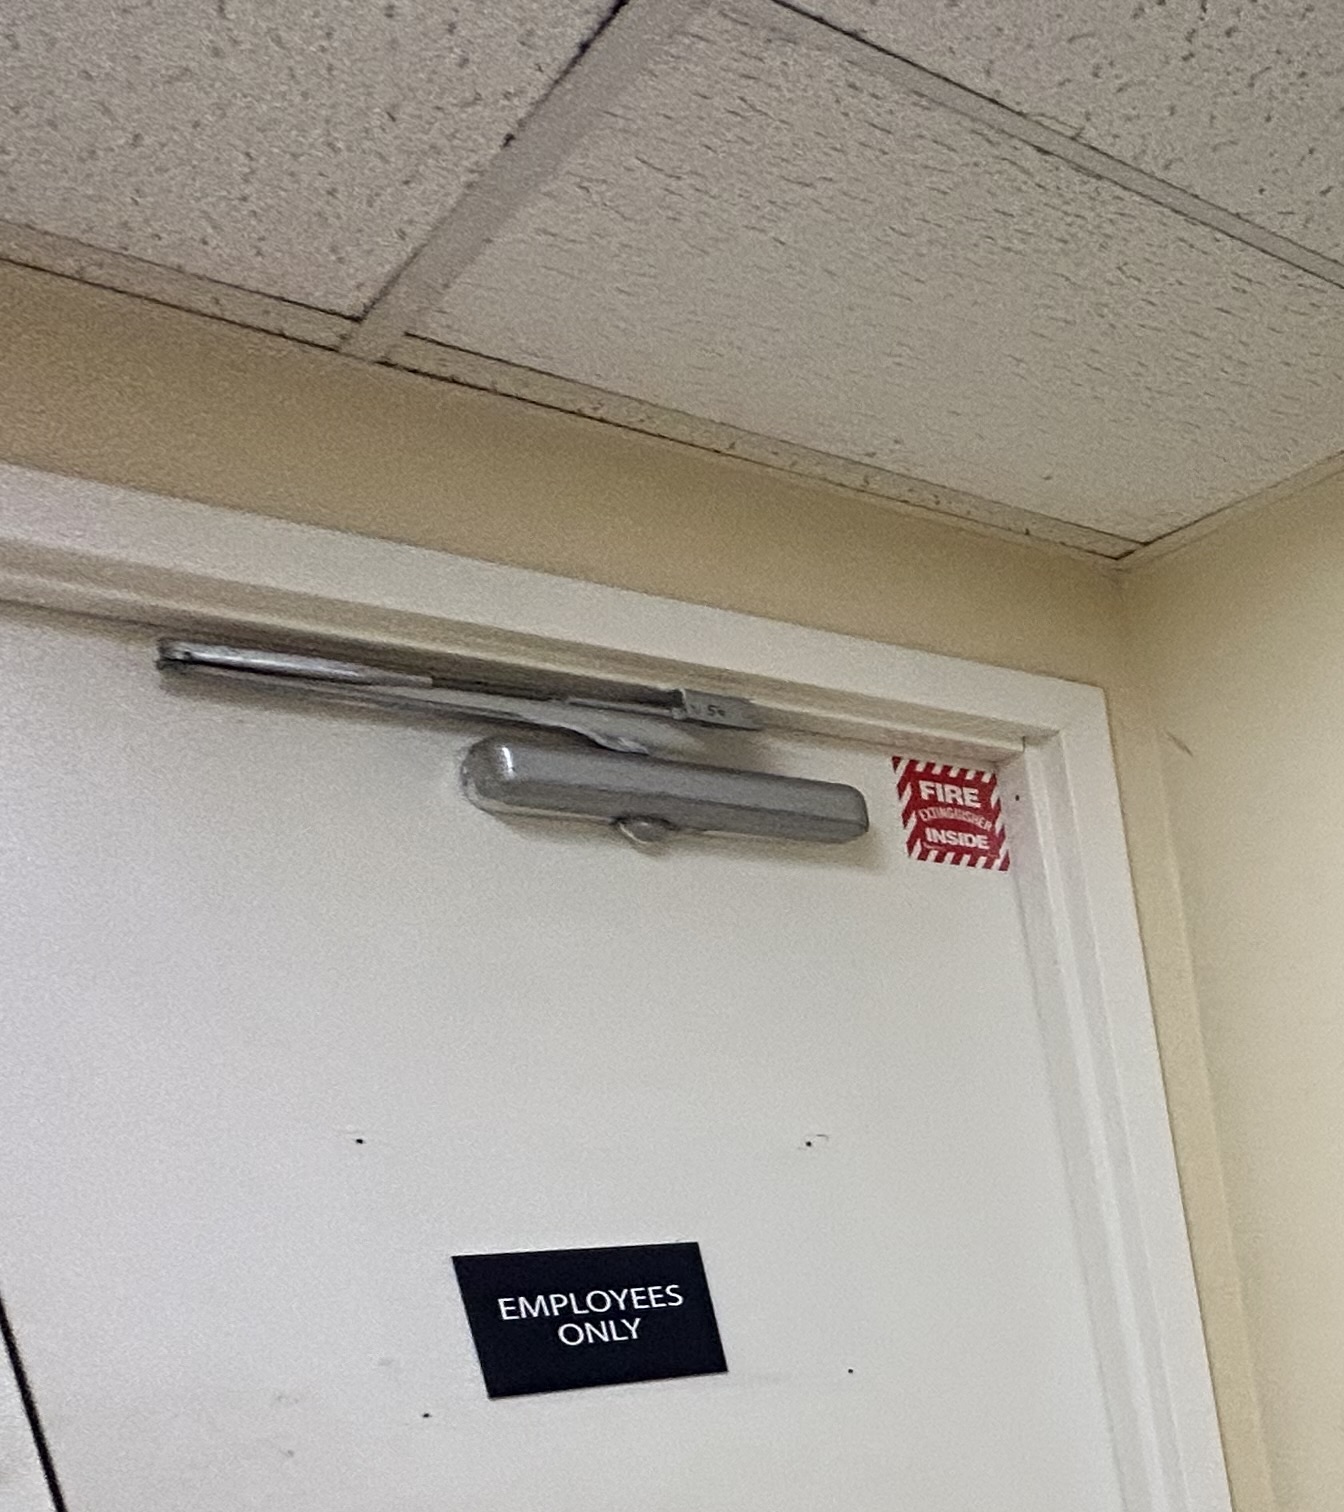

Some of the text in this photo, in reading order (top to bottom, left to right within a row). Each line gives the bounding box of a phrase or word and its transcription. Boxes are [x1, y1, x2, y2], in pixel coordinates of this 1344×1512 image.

[918, 780, 981, 808] FIRE
[925, 827, 990, 849] INSIDE
[498, 1284, 684, 1320] EMPLOYEES
[558, 1317, 642, 1346] ONLY
